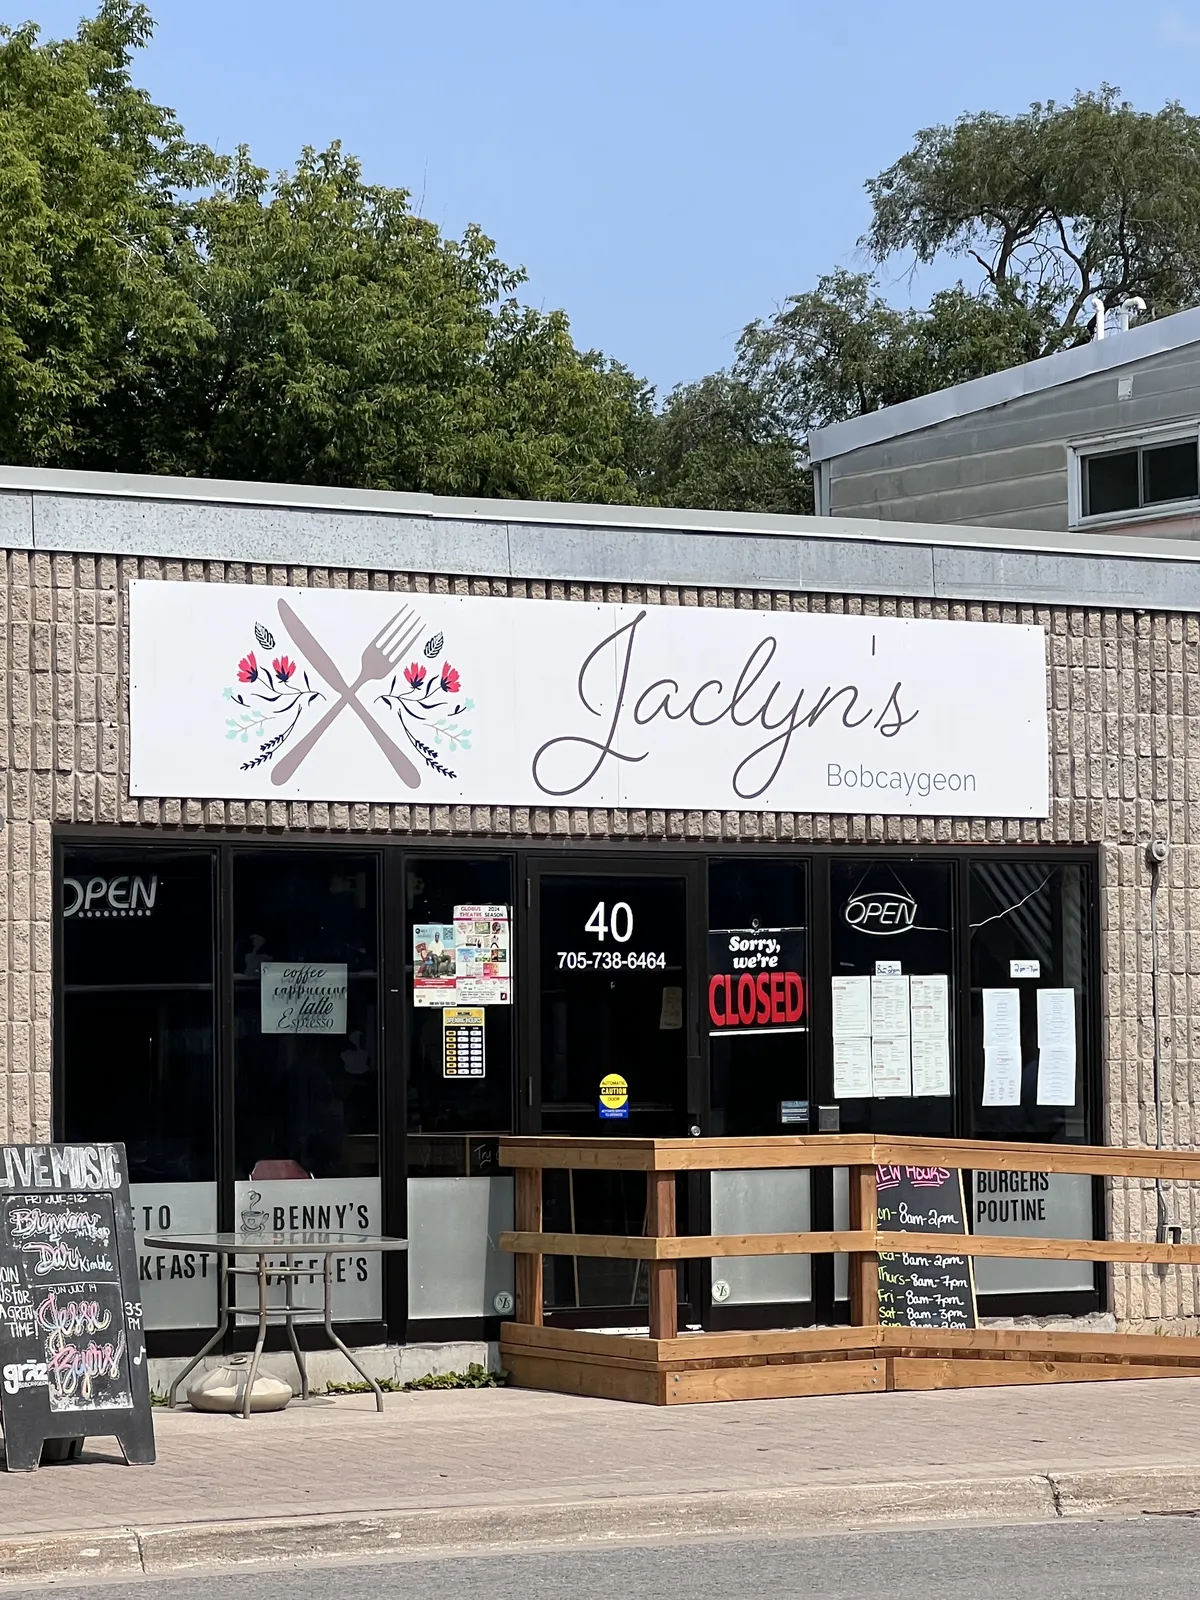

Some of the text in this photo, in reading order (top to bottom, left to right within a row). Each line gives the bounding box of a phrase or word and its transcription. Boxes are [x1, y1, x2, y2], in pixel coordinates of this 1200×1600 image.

[532, 610, 919, 798] Jaclyn's
[827, 763, 976, 797] Bobcaygeon
[585, 901, 633, 942] 40
[846, 902, 917, 925] OPEN
[728, 936, 781, 954] Sorry,
[557, 952, 666, 969] 705-738-6464
[733, 952, 778, 969] we're
[282, 965, 328, 984] coffee
[300, 996, 334, 1015] latte
[709, 972, 804, 1026] CLOSED
[278, 1007, 334, 1033] Espresso
[601, 1087, 627, 1095] CAUTION
[0, 1147, 121, 1189] IVE MUSIC
[976, 1170, 1050, 1194] BURGERS
[142, 1205, 170, 1230] TO
[273, 1202, 369, 1231] BENNY'S
[976, 1198, 1046, 1223] POUTINE
[48, 1286, 66, 1295] SUN
[68, 1282, 85, 1294] JULY
[4, 1321, 39, 1340] TIME!
[128, 1318, 141, 1330] PM
